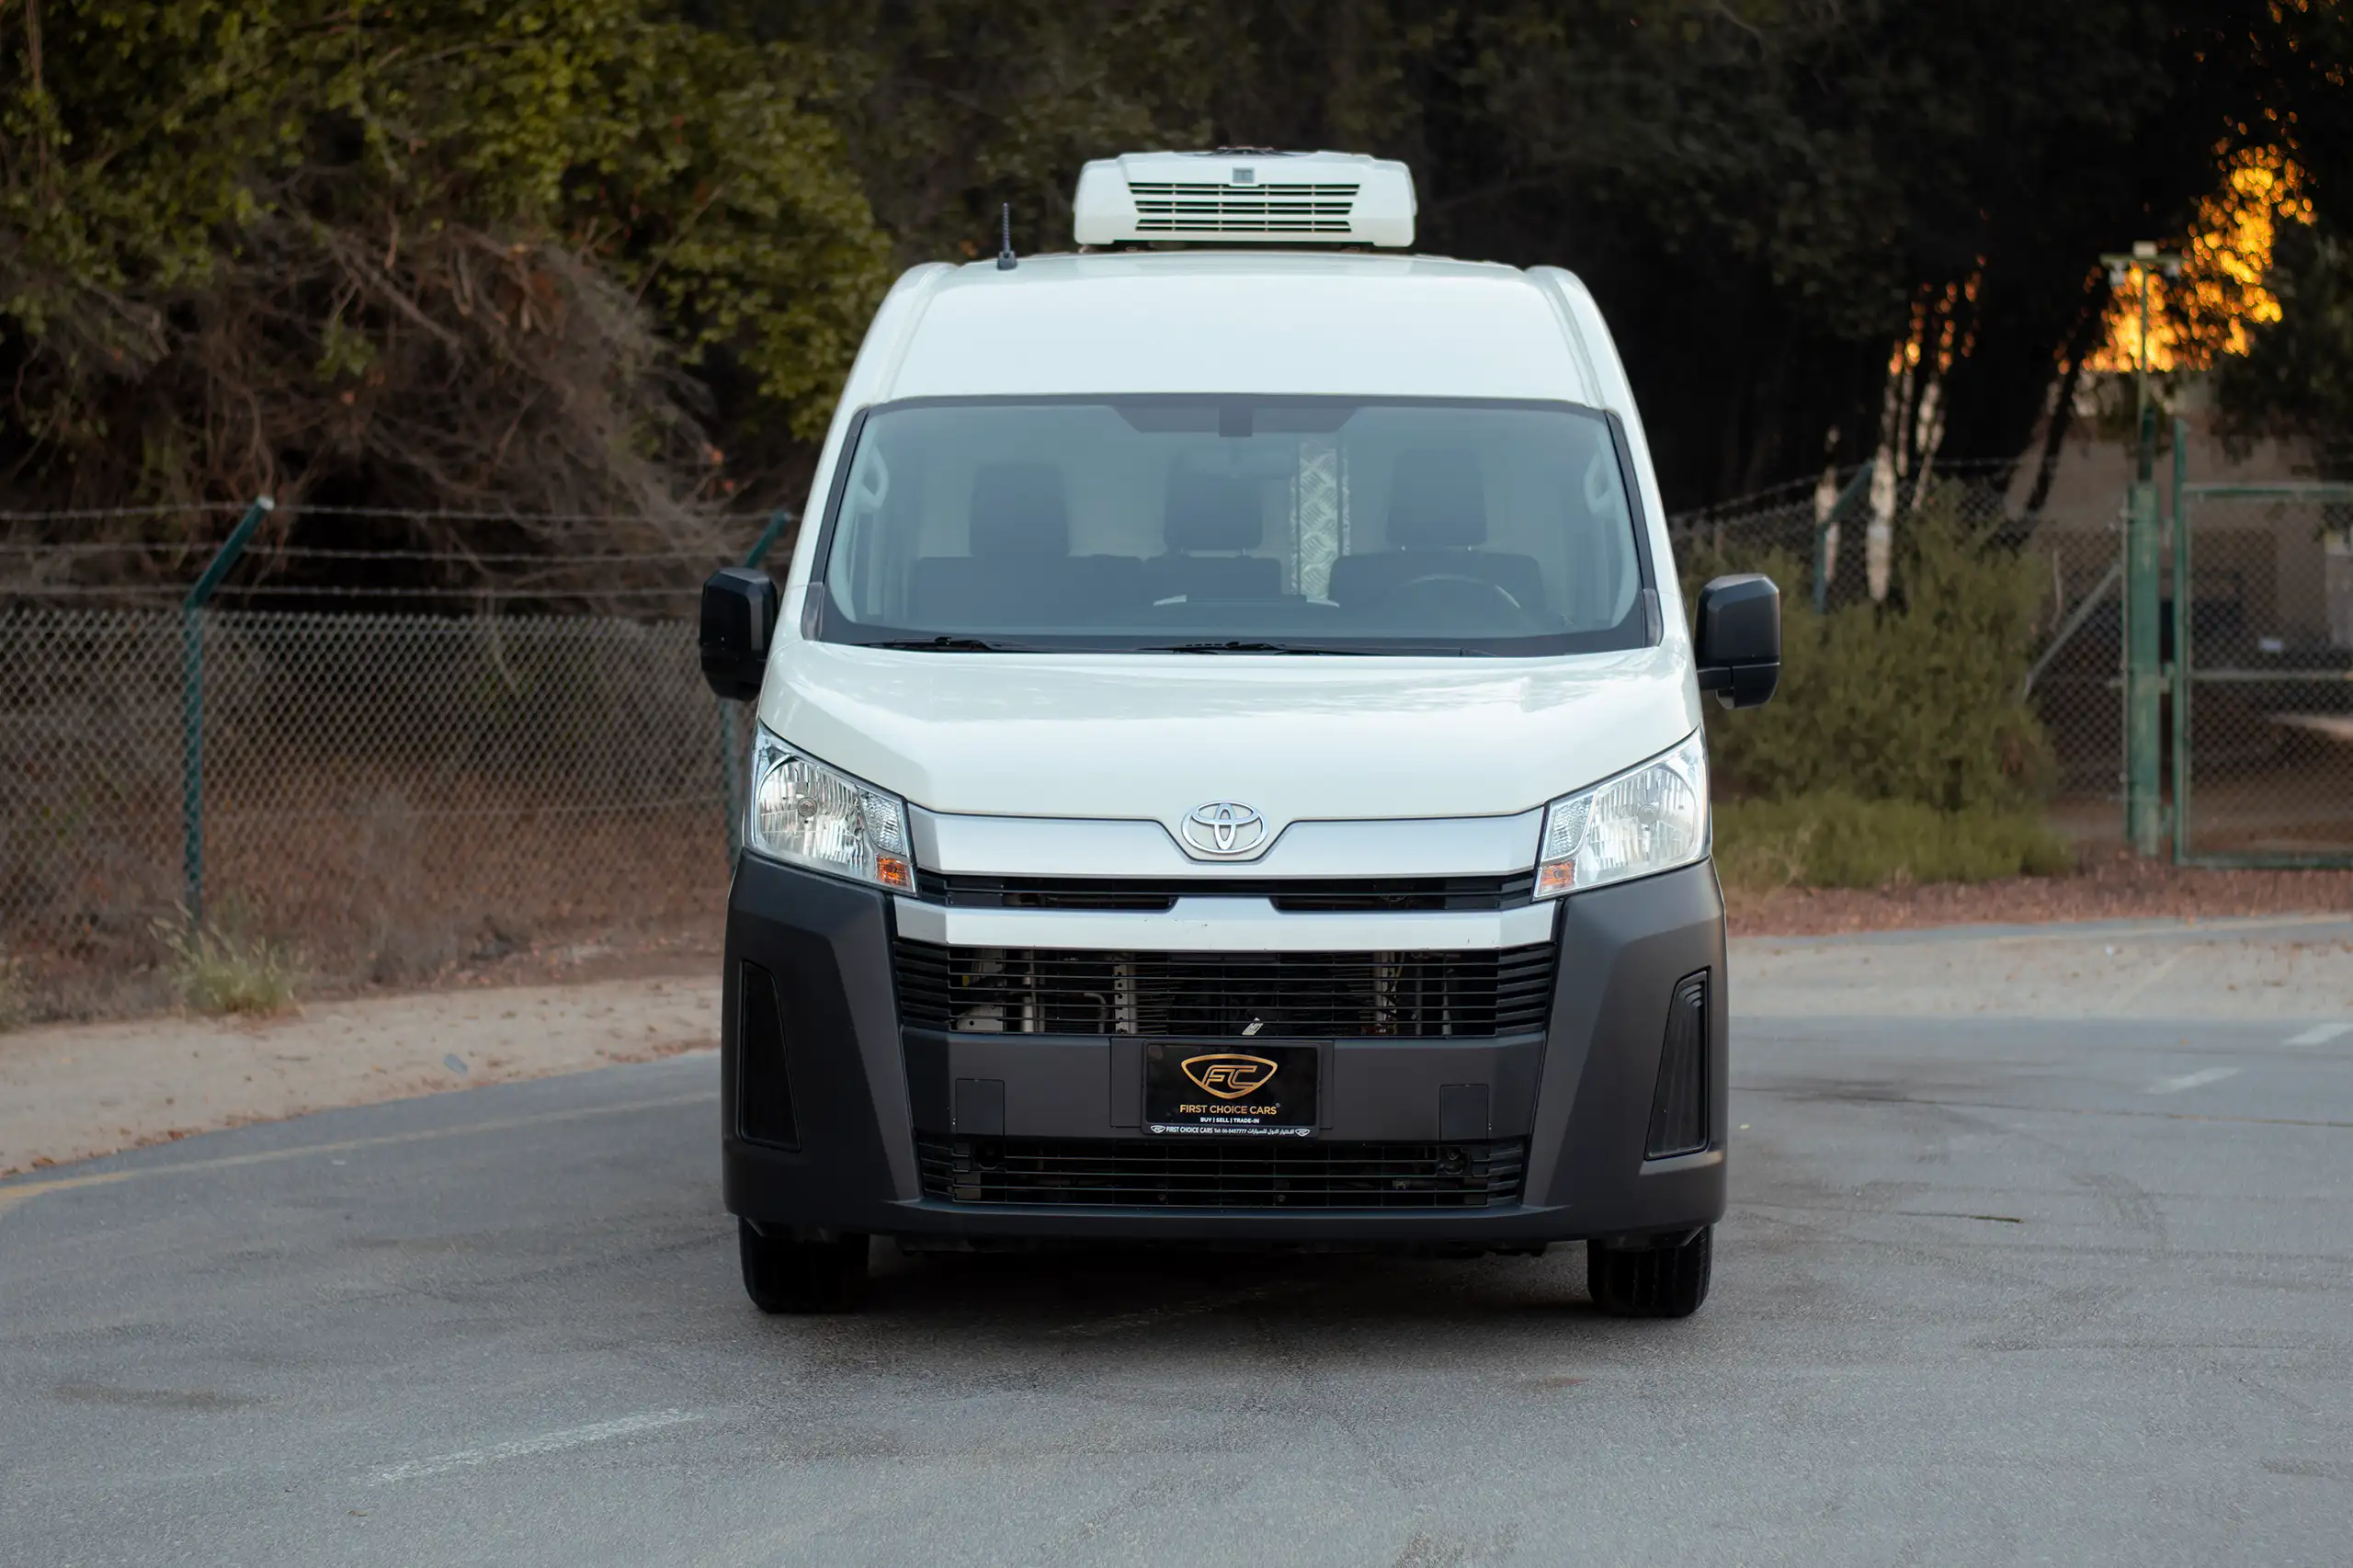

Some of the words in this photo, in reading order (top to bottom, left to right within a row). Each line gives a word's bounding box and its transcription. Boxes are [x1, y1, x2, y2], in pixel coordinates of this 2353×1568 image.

[1202, 1064, 1258, 1089] FC
[1179, 1104, 1208, 1113] FIRST
[1209, 1105, 1248, 1115] CHOICE
[1249, 1106, 1277, 1115] CARS
[1179, 1126, 1199, 1134] CHOICE
